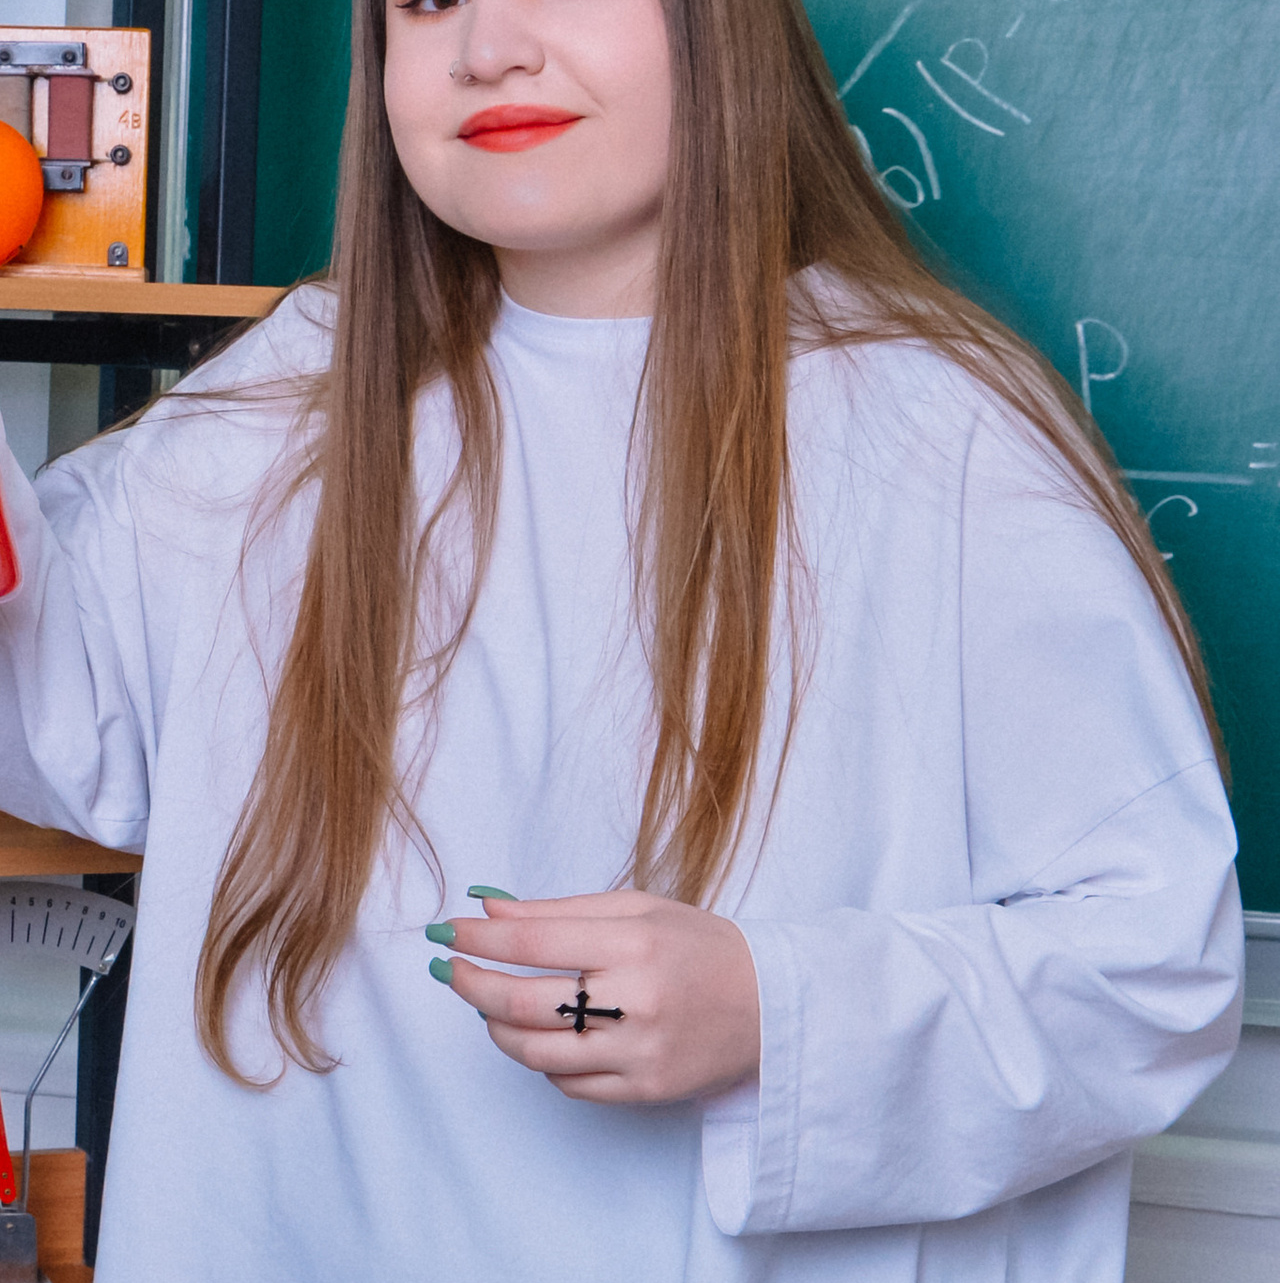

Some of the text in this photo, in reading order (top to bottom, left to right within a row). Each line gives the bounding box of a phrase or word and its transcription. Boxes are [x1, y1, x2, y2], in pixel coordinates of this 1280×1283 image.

[10, 896, 17, 906] 4
[28, 897, 35, 907] 5
[46, 898, 53, 908] 6
[64, 901, 72, 911] 7
[81, 905, 89, 915] 8
[99, 911, 106, 920] 9
[115, 917, 127, 929] 10
